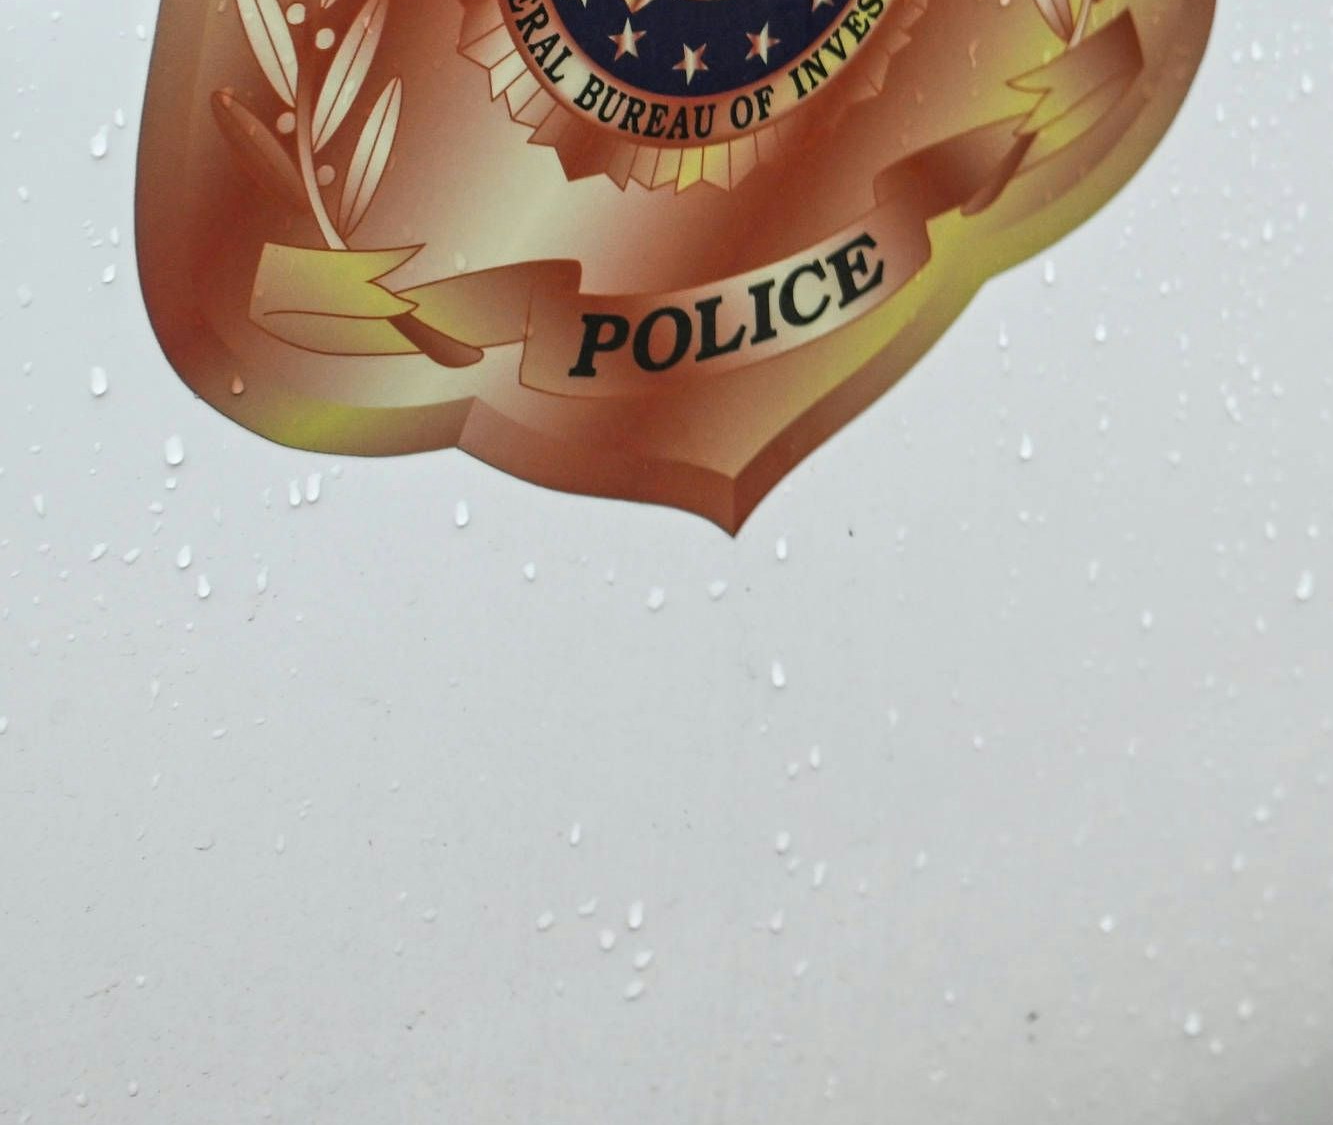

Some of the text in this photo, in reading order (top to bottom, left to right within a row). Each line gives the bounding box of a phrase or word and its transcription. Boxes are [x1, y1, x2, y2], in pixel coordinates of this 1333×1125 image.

[573, 73, 714, 140] BUREAU
[730, 86, 775, 130] OF
[568, 231, 885, 378] POLICE
